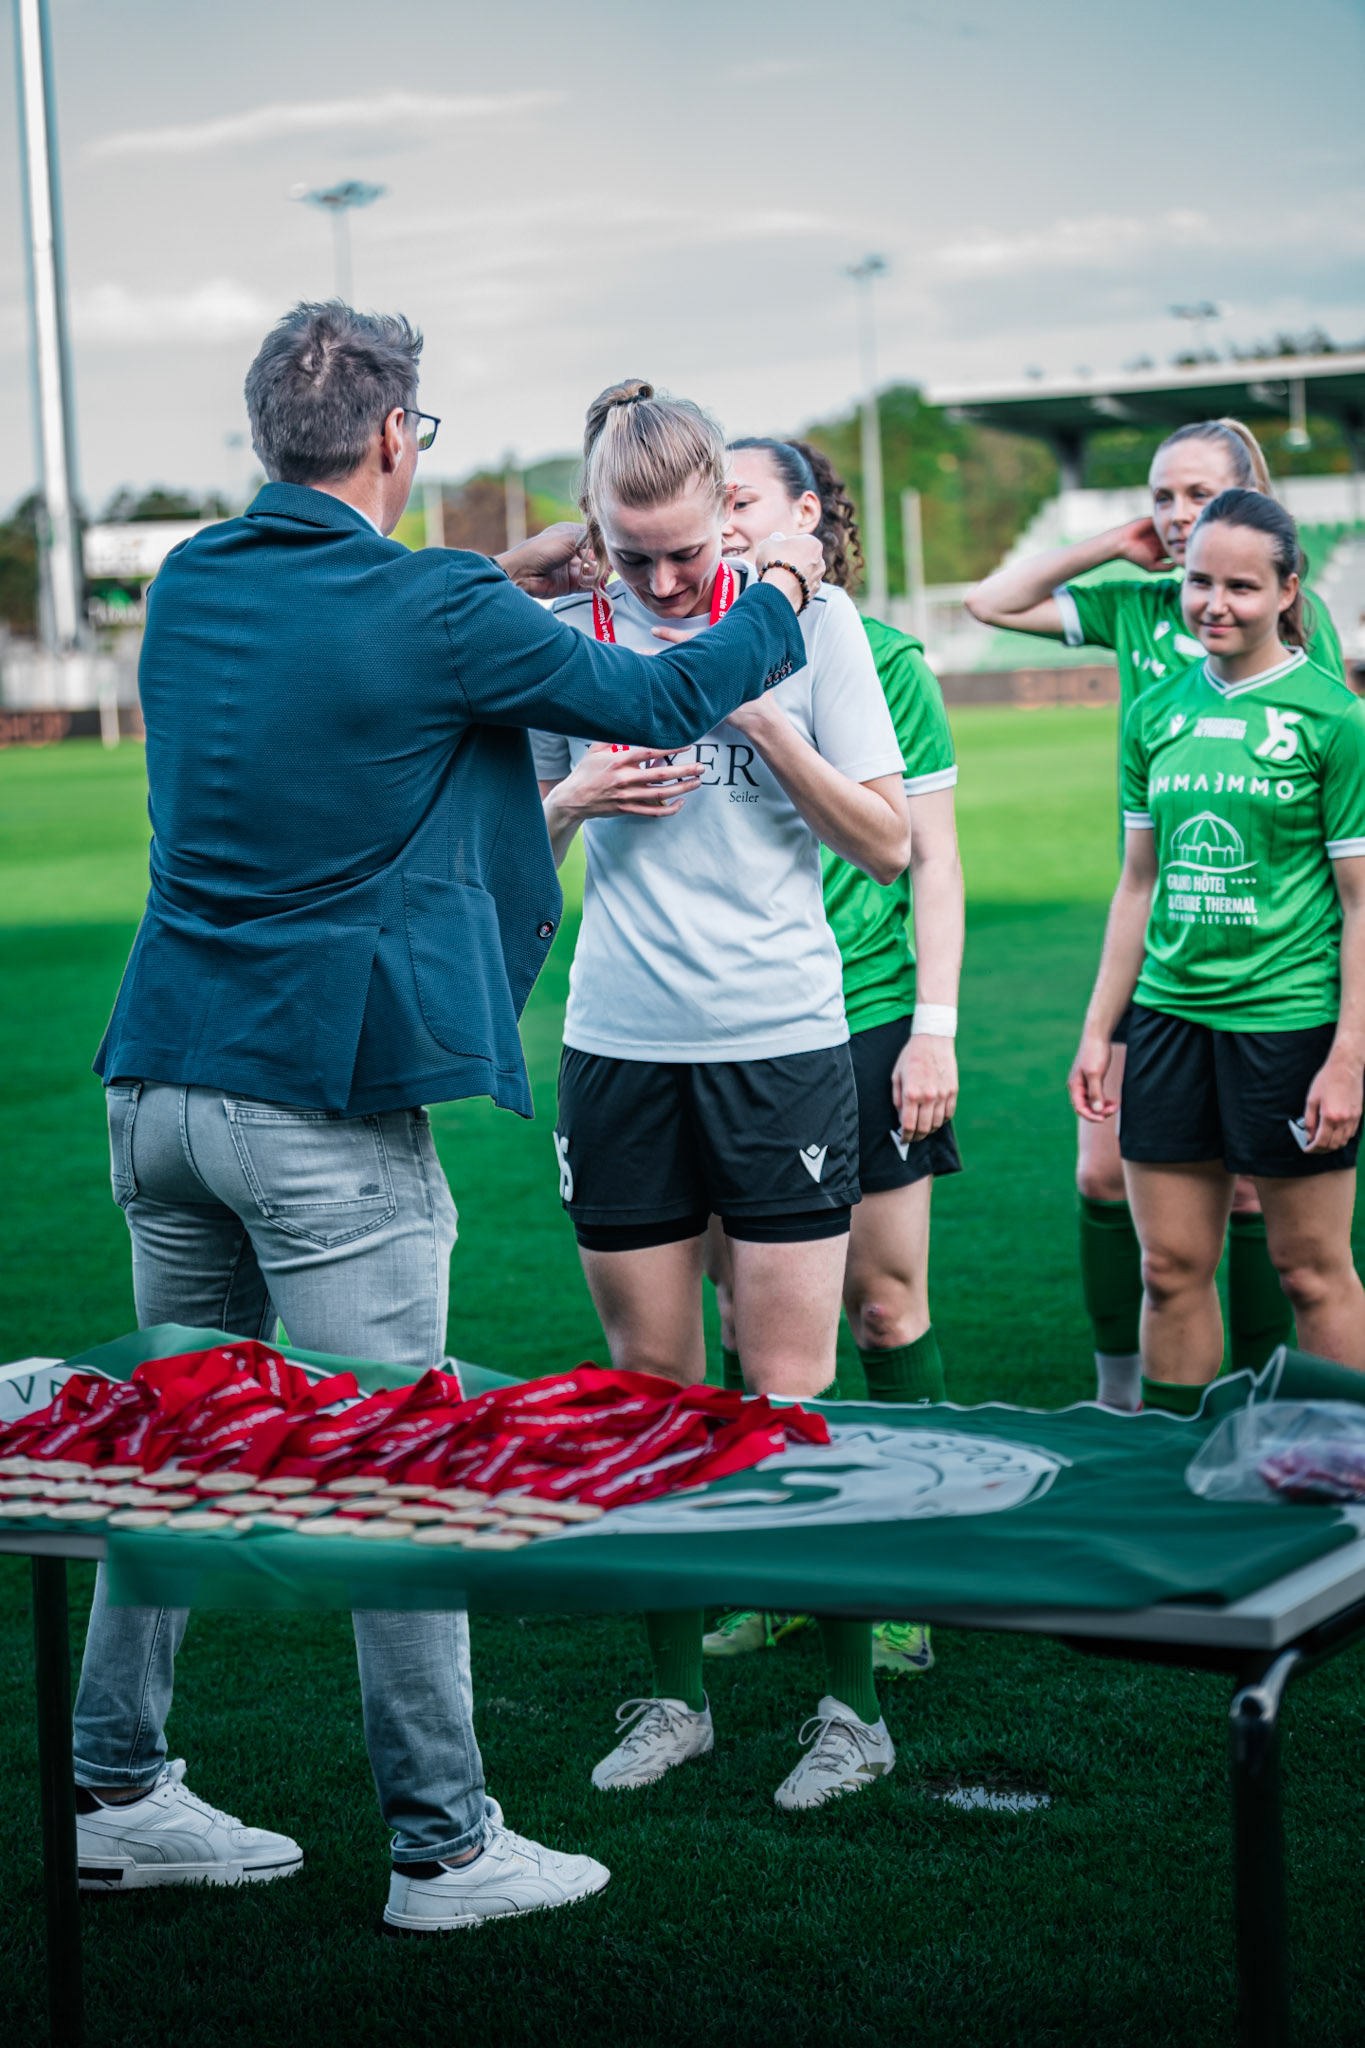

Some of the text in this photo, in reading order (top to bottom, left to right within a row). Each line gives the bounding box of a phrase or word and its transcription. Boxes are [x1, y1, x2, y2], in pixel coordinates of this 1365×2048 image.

[729, 790, 760, 803] Seiler
[1193, 872, 1227, 894] HÔTEL
[1204, 896, 1258, 914] THERMAL
